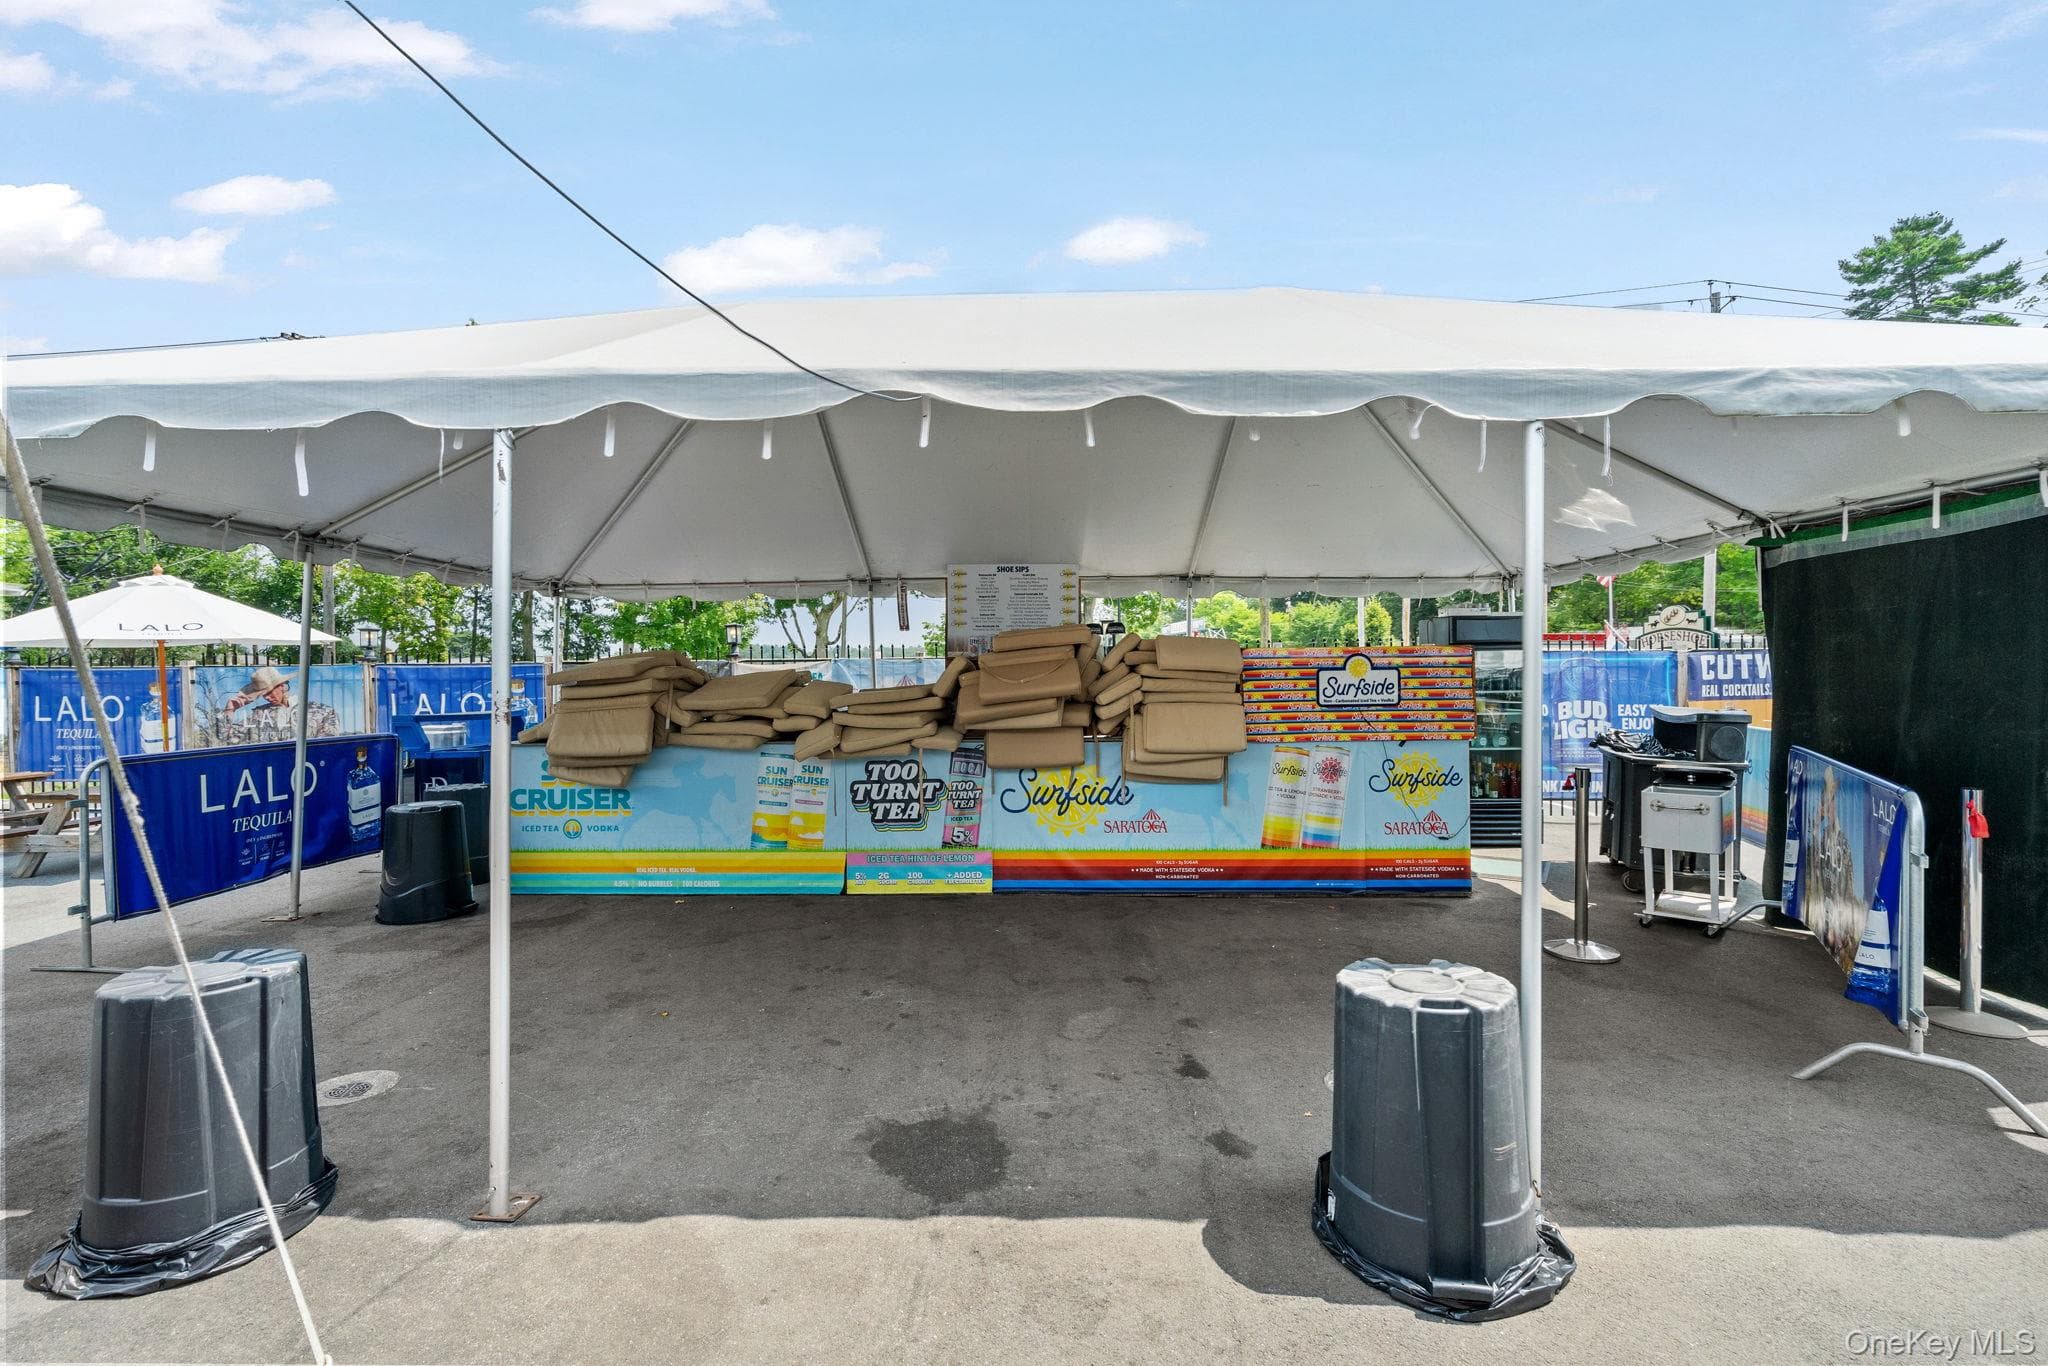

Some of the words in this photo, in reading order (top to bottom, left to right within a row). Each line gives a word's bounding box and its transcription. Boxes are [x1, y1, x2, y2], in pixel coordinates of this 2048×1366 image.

[119, 622, 204, 632] LALO
[1641, 631, 1707, 647] HORSESHOE
[1322, 676, 1395, 698] Surfside
[1702, 684, 1719, 697] REAL
[34, 695, 124, 722] LALO
[1558, 700, 1607, 720] BUD
[1618, 704, 1647, 716] EASY
[1622, 718, 1654, 730] ENJO
[766, 766, 788, 776] SUN
[801, 764, 824, 775] SUN
[868, 763, 918, 781] TOO
[1368, 758, 1463, 794] Surfside
[758, 776, 794, 788] CRUISER
[794, 774, 830, 786] CRUISER
[952, 782, 974, 791] TOO
[200, 762, 318, 814] LALO
[853, 782, 940, 800] TURNT
[948, 790, 982, 800] TURNT
[1000, 767, 1135, 817] Surfside
[510, 788, 632, 812] CRUISER
[953, 800, 975, 808] TEA
[872, 802, 920, 820] TEA
[1872, 796, 1897, 824] LALO
[232, 808, 294, 833] TEQUILA
[1104, 820, 1168, 834] SARATOGA
[1384, 822, 1449, 835] SARATOGA
[867, 854, 888, 862] ICED
[890, 854, 905, 862] TEA
[906, 854, 928, 862] HINT
[930, 854, 941, 862] OF
[943, 854, 976, 862] LEMON
